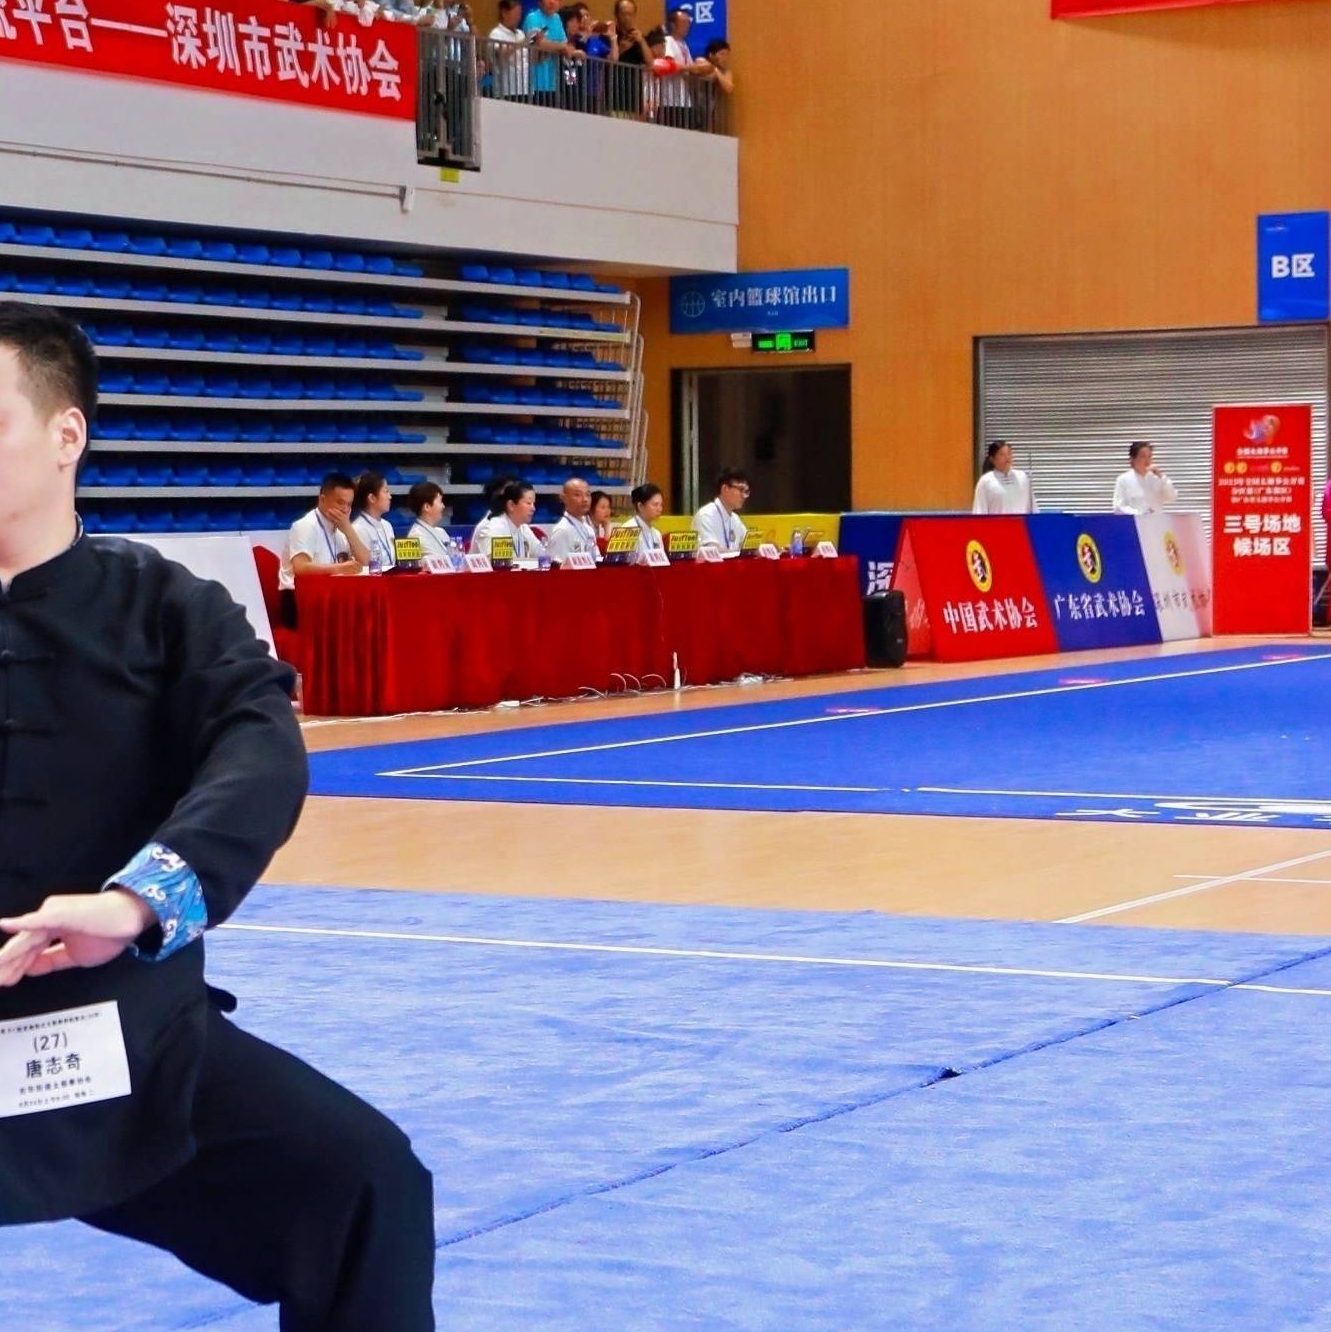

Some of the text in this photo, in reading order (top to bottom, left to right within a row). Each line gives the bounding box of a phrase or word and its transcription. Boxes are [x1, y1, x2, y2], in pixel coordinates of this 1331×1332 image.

[1271, 253, 1315, 279] B区
[1223, 514, 1302, 534] 三号场地
[1233, 537, 1291, 556] 候场区
[942, 595, 1039, 635] 中国武术协会
[1053, 589, 1146, 621] 广东省武术协会
[33, 1032, 69, 1053] (27)
[25, 1053, 84, 1079] 唐志奇
